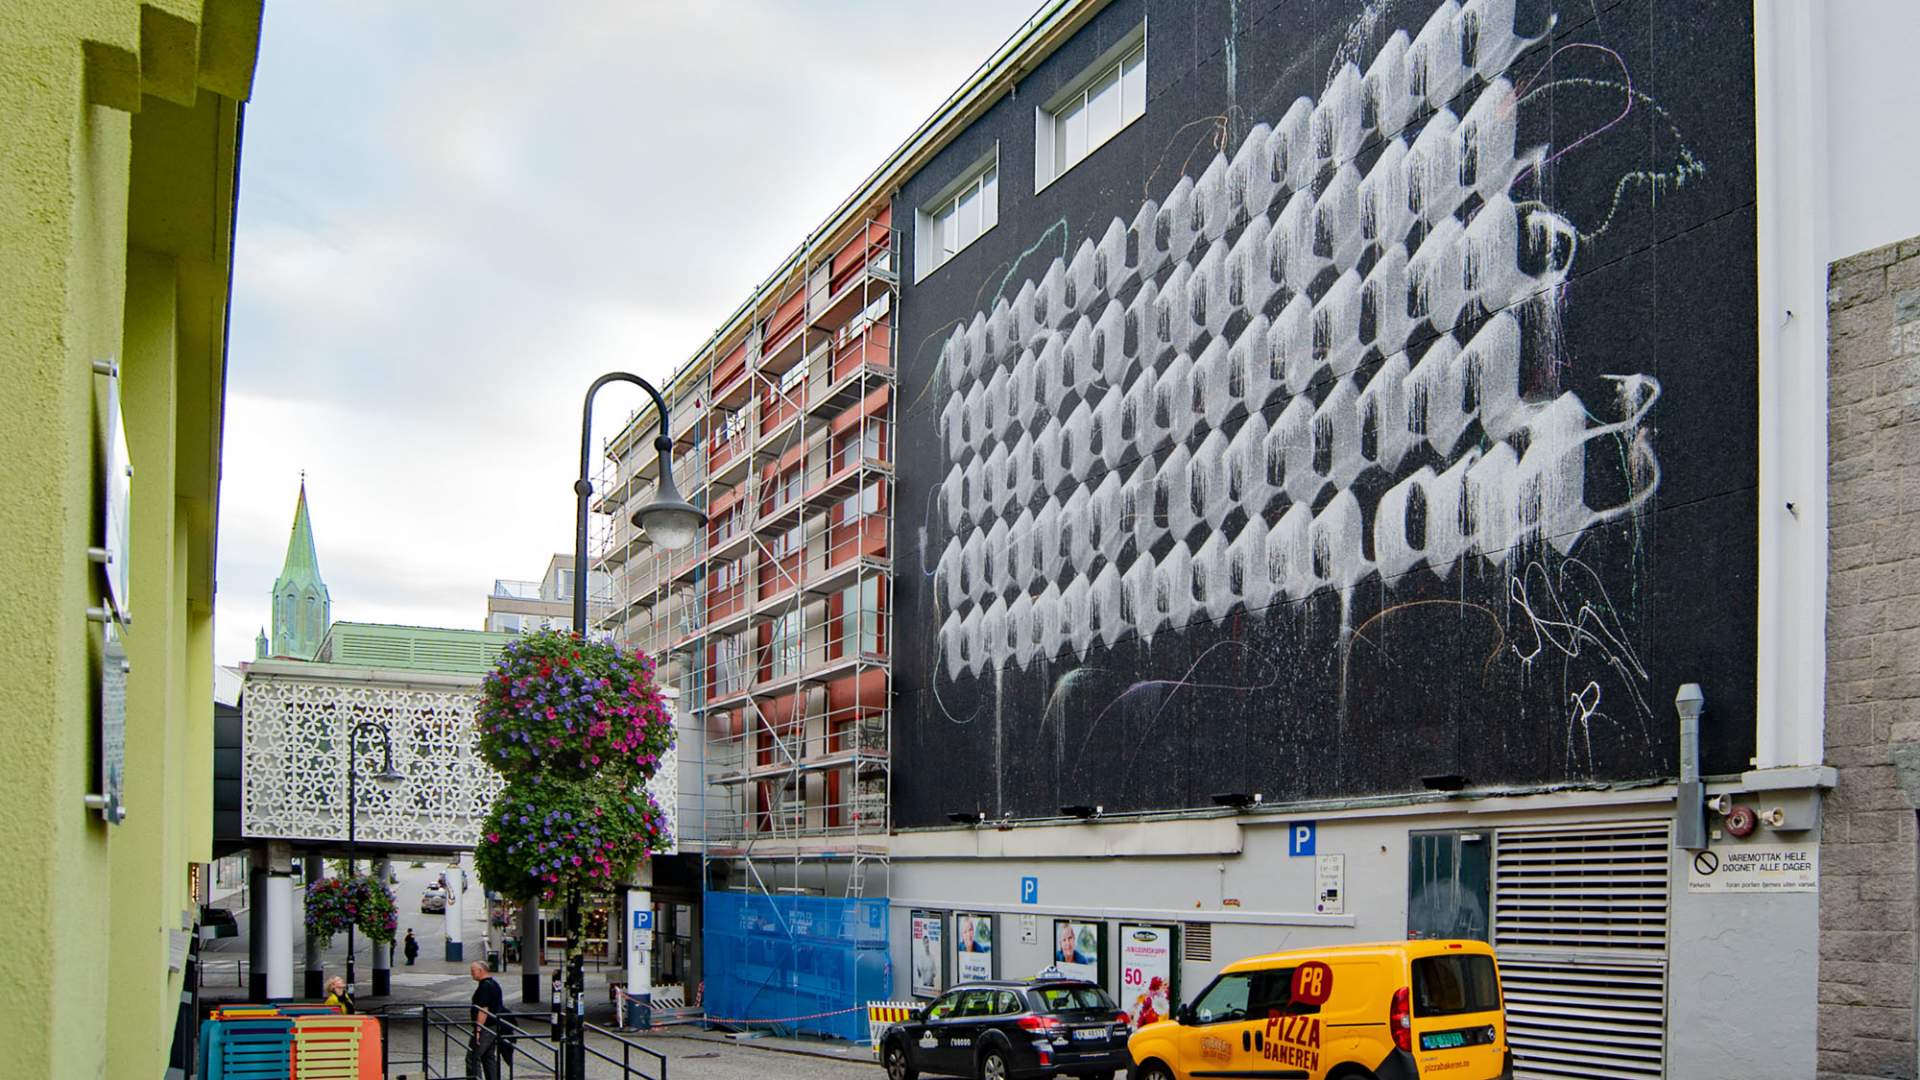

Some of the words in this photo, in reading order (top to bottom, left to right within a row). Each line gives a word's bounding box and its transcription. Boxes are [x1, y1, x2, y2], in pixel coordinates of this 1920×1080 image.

[1295, 826, 1311, 853] P
[1722, 863, 1755, 872] DØGNET
[1759, 863, 1780, 872] ALLE
[1783, 862, 1812, 871] DAGER
[1728, 852, 1782, 862] VAREMOTTAK
[1785, 852, 1807, 861] HELE
[1025, 880, 1034, 901] P
[638, 912, 648, 928] P
[1299, 967, 1323, 996] PB
[1266, 1008, 1320, 1049] PIZZA
[1264, 1042, 1319, 1072] BAKEREN
